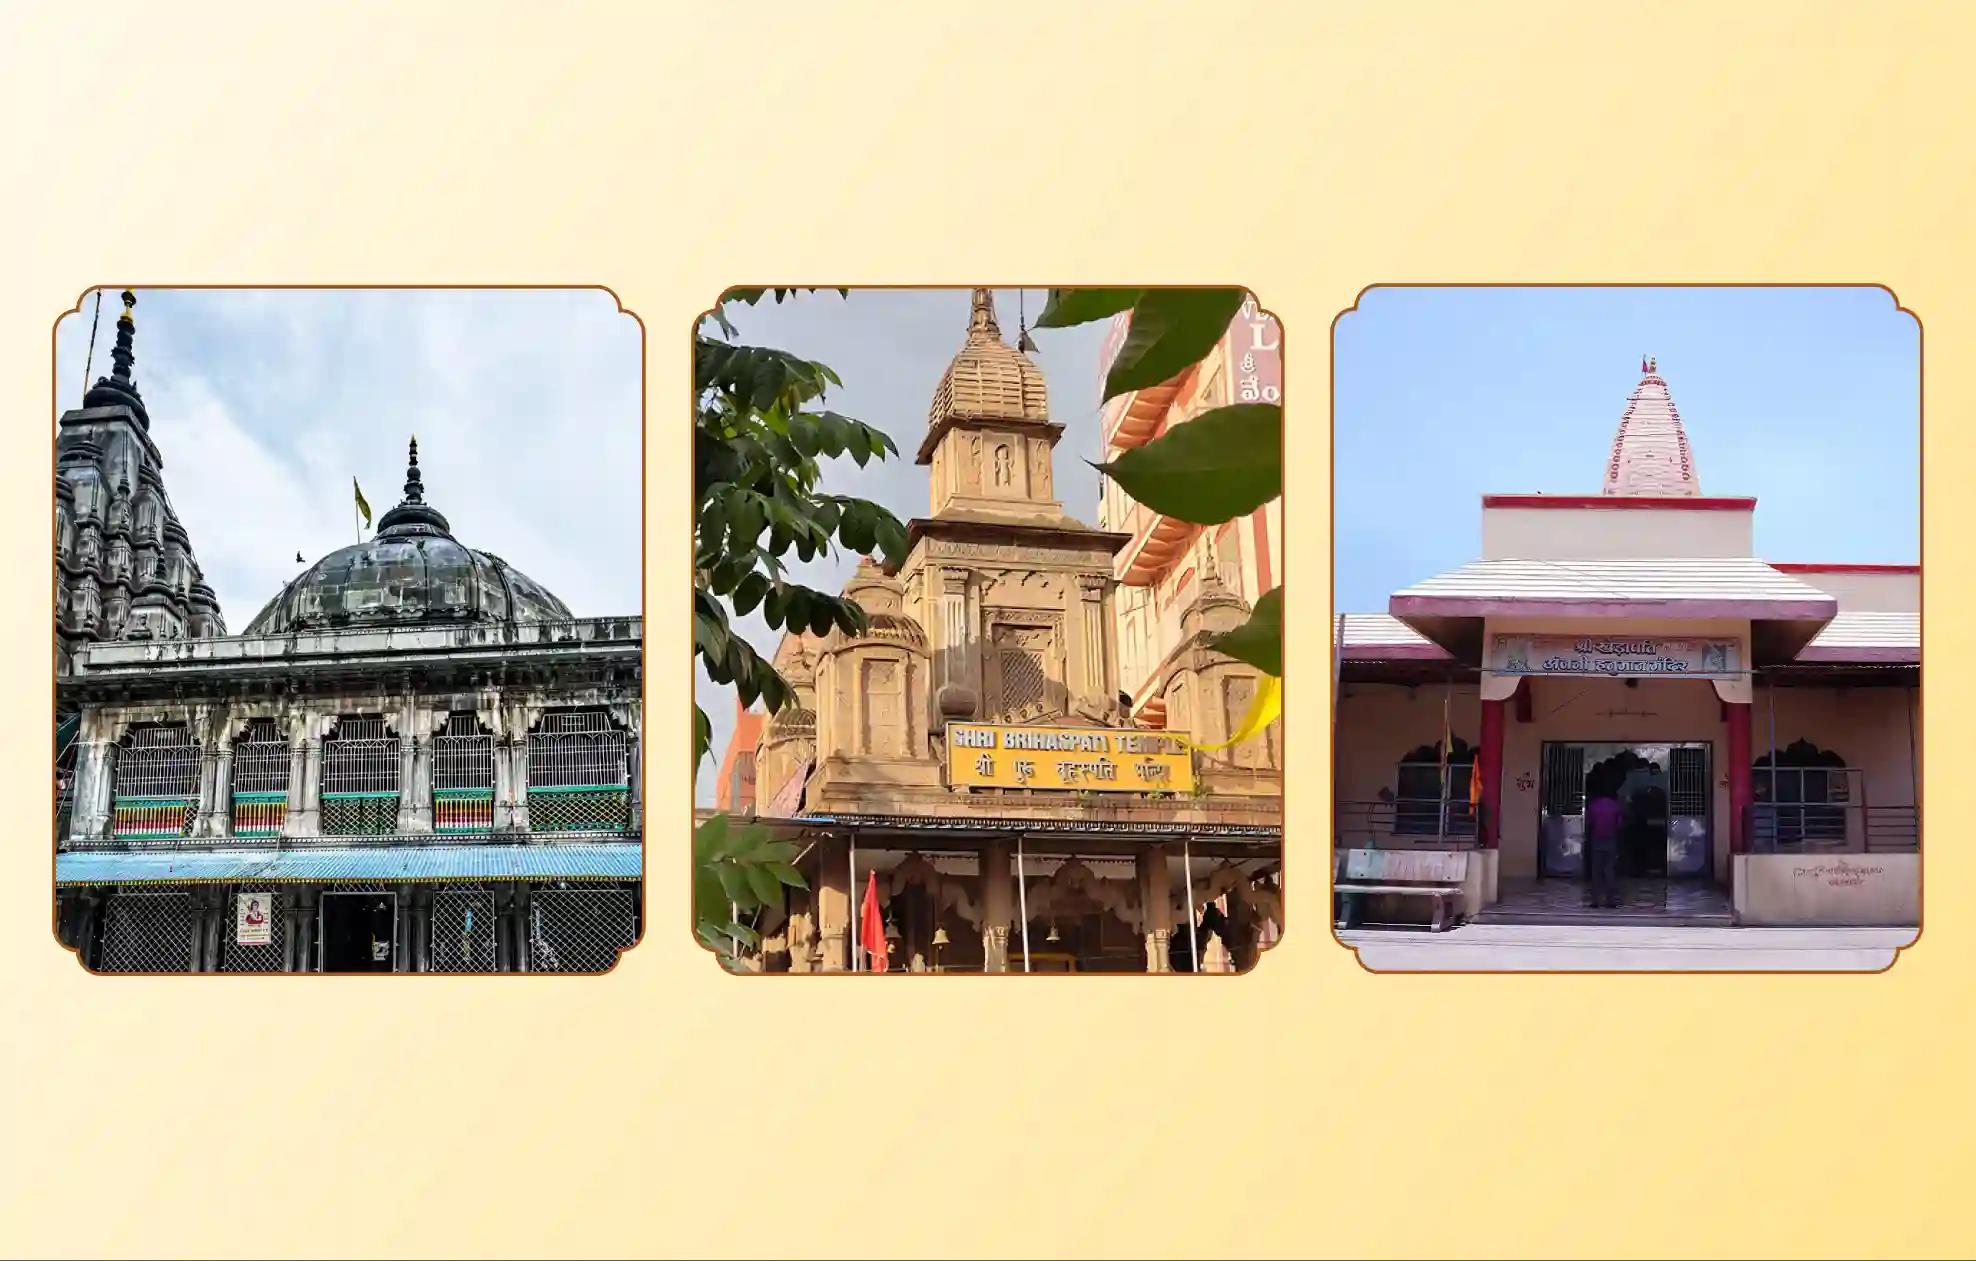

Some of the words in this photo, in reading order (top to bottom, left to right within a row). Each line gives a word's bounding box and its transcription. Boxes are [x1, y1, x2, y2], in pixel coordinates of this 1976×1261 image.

[955, 729, 996, 747] SHRI
[1004, 731, 1109, 752] BRIHASPATI
[975, 752, 995, 776] श्री
